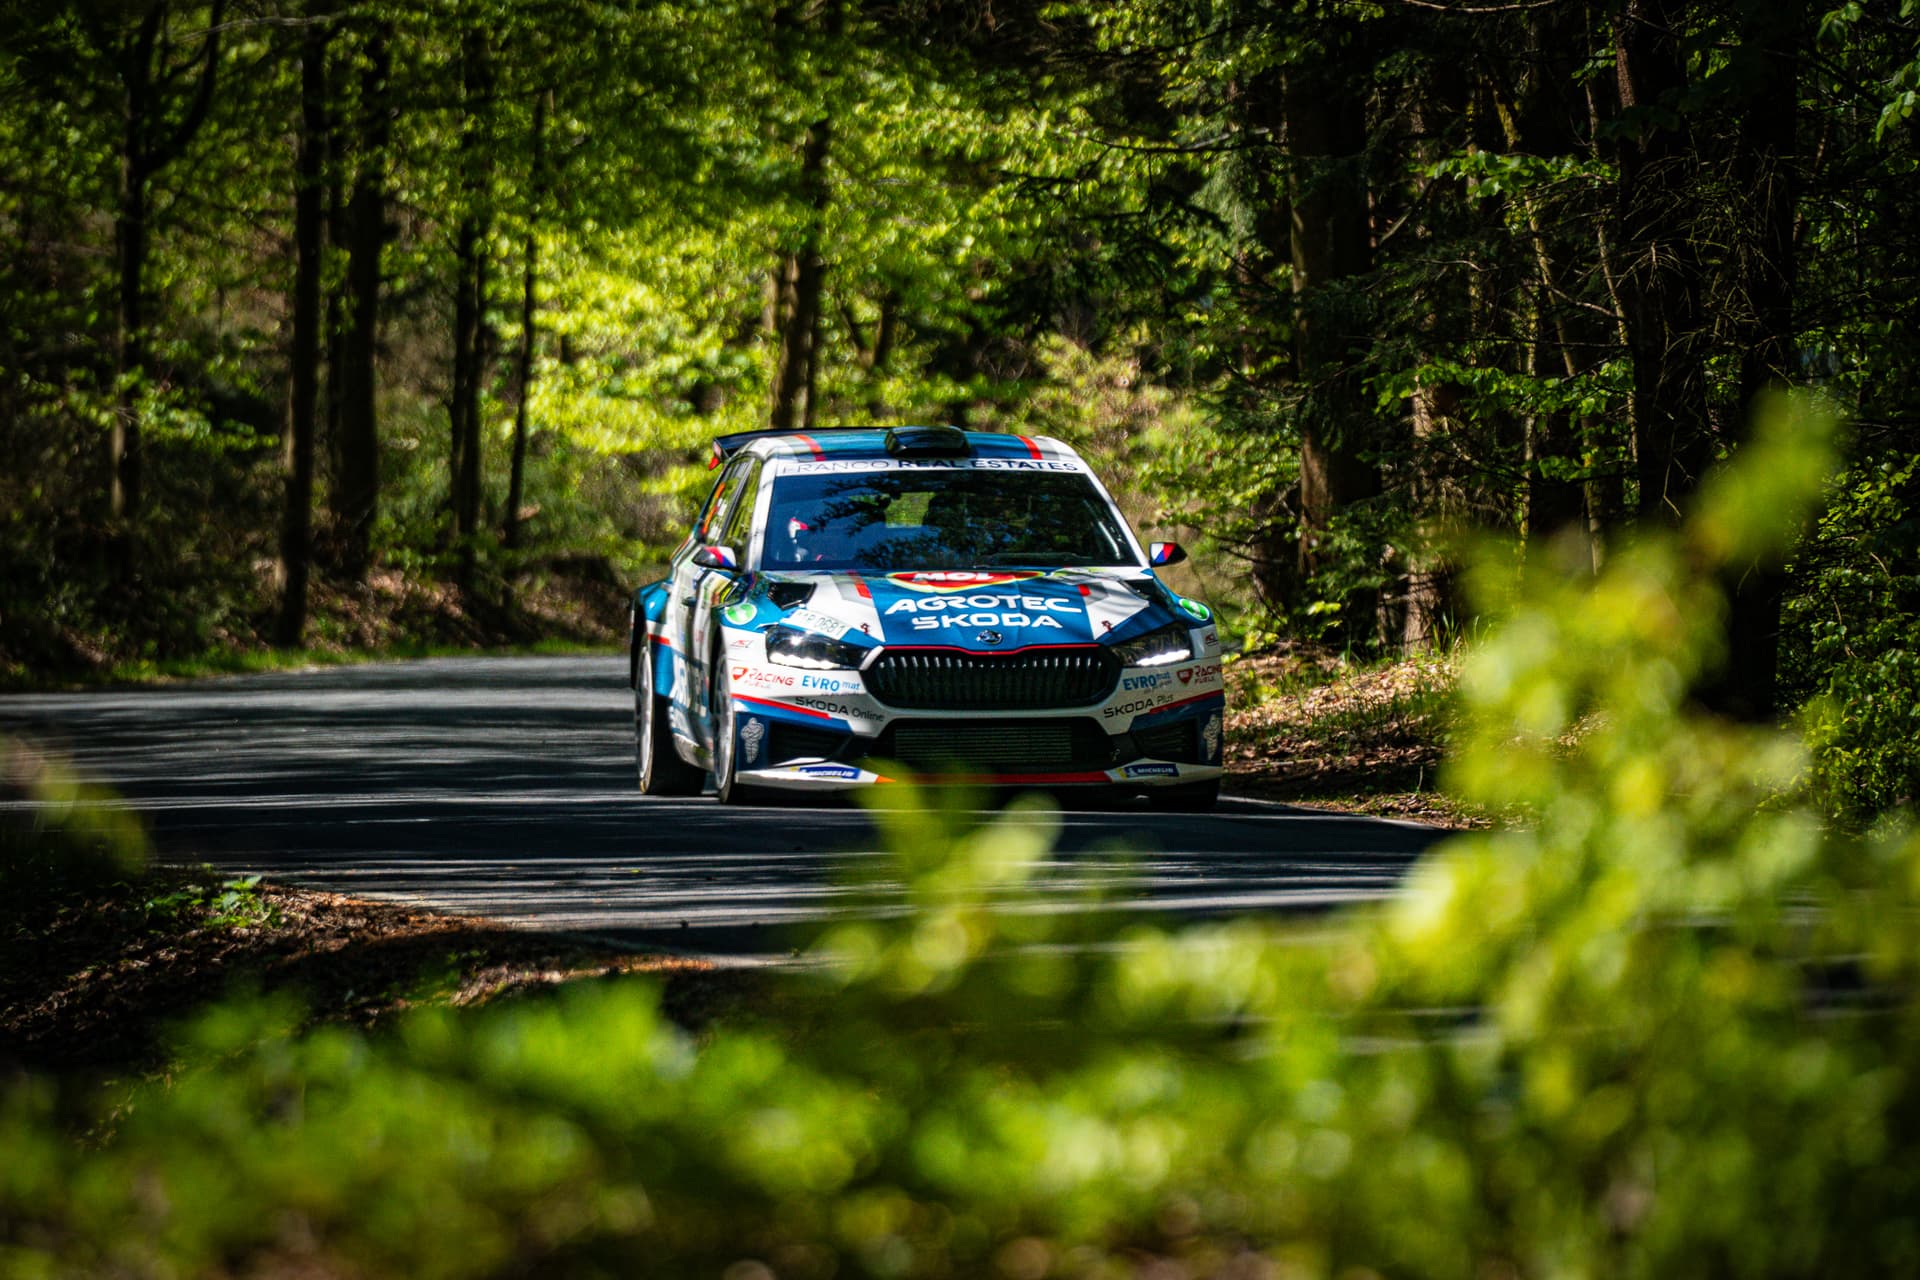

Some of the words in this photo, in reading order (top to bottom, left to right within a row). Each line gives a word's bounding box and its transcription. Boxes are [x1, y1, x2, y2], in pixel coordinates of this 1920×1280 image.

[783, 460, 889, 474] FRANCO
[899, 459, 965, 469] REAL
[971, 459, 1078, 471] ESTATES
[884, 594, 1082, 615] AGROTEC
[748, 668, 795, 686] RACING
[802, 675, 840, 692] EVRO
[1123, 675, 1157, 691] EVRO
[851, 707, 885, 723] Online
